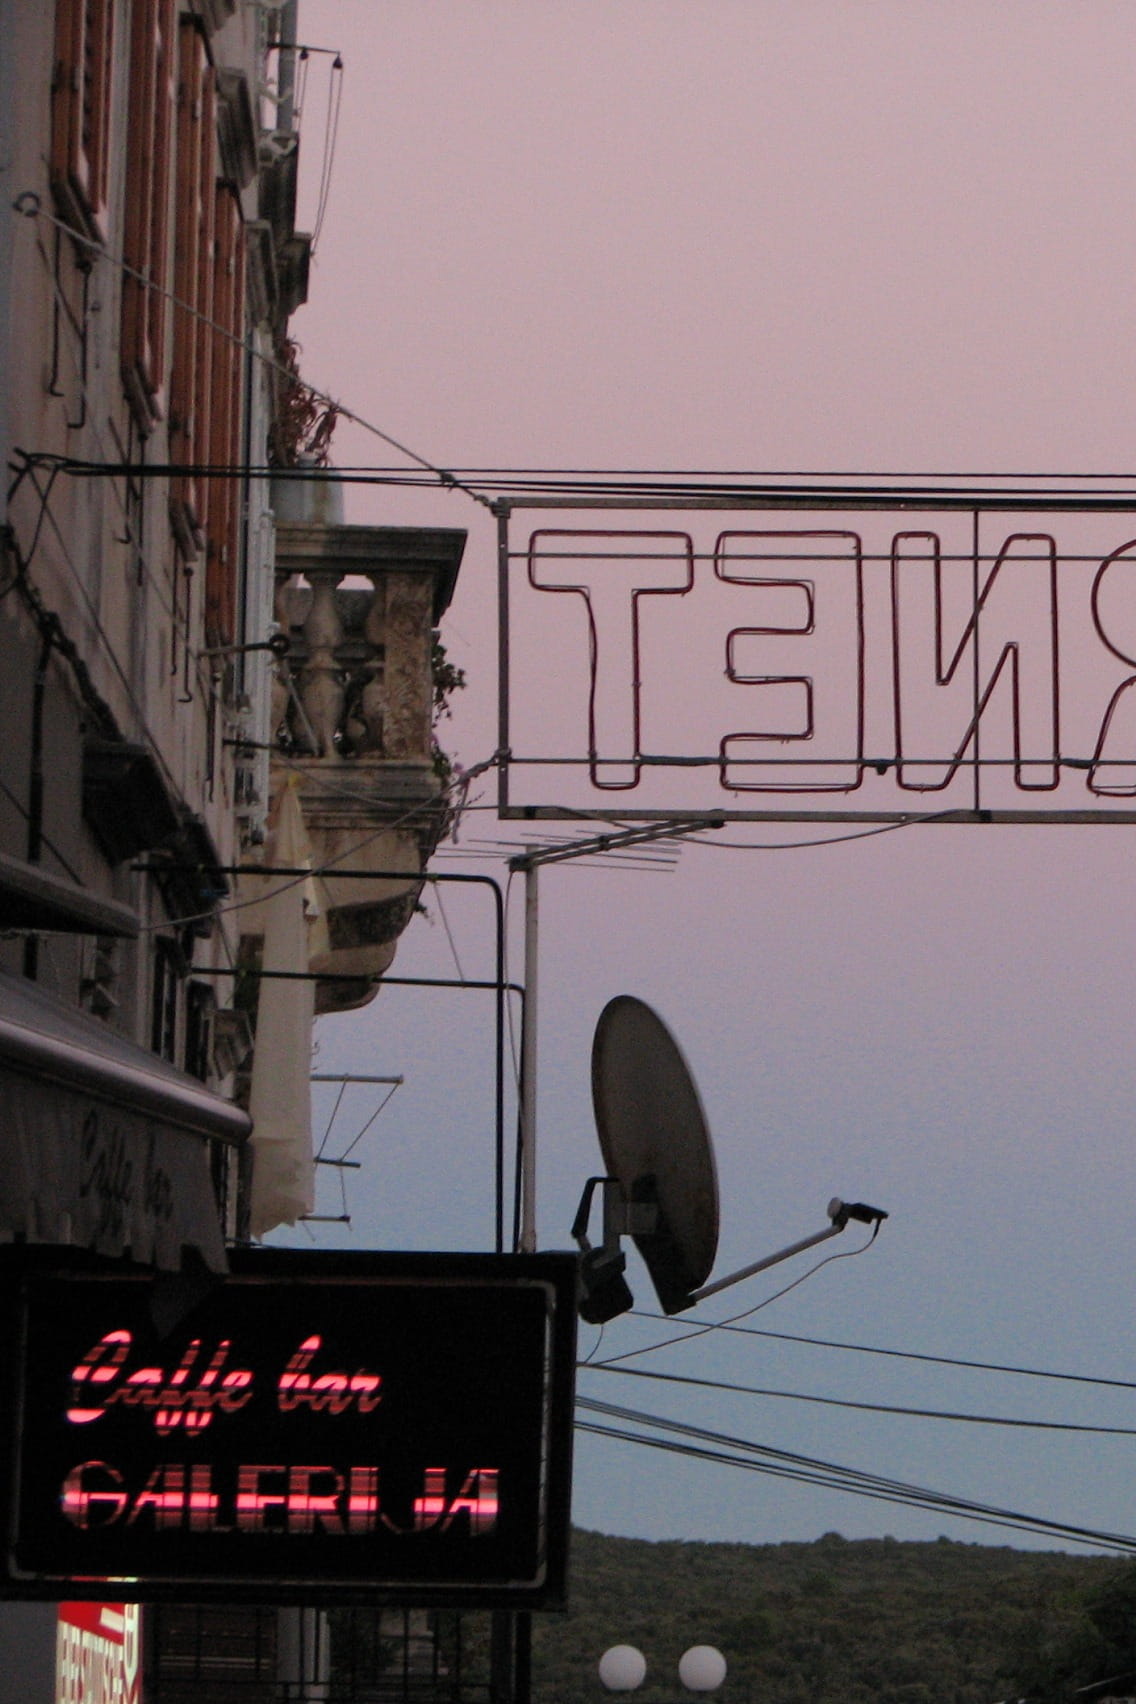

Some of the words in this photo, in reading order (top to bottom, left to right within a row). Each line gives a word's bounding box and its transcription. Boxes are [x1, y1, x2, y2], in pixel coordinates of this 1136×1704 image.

[66, 1330, 254, 1436] Caffe
[279, 1334, 382, 1414] bar
[61, 1460, 500, 1534] GALERIJA
